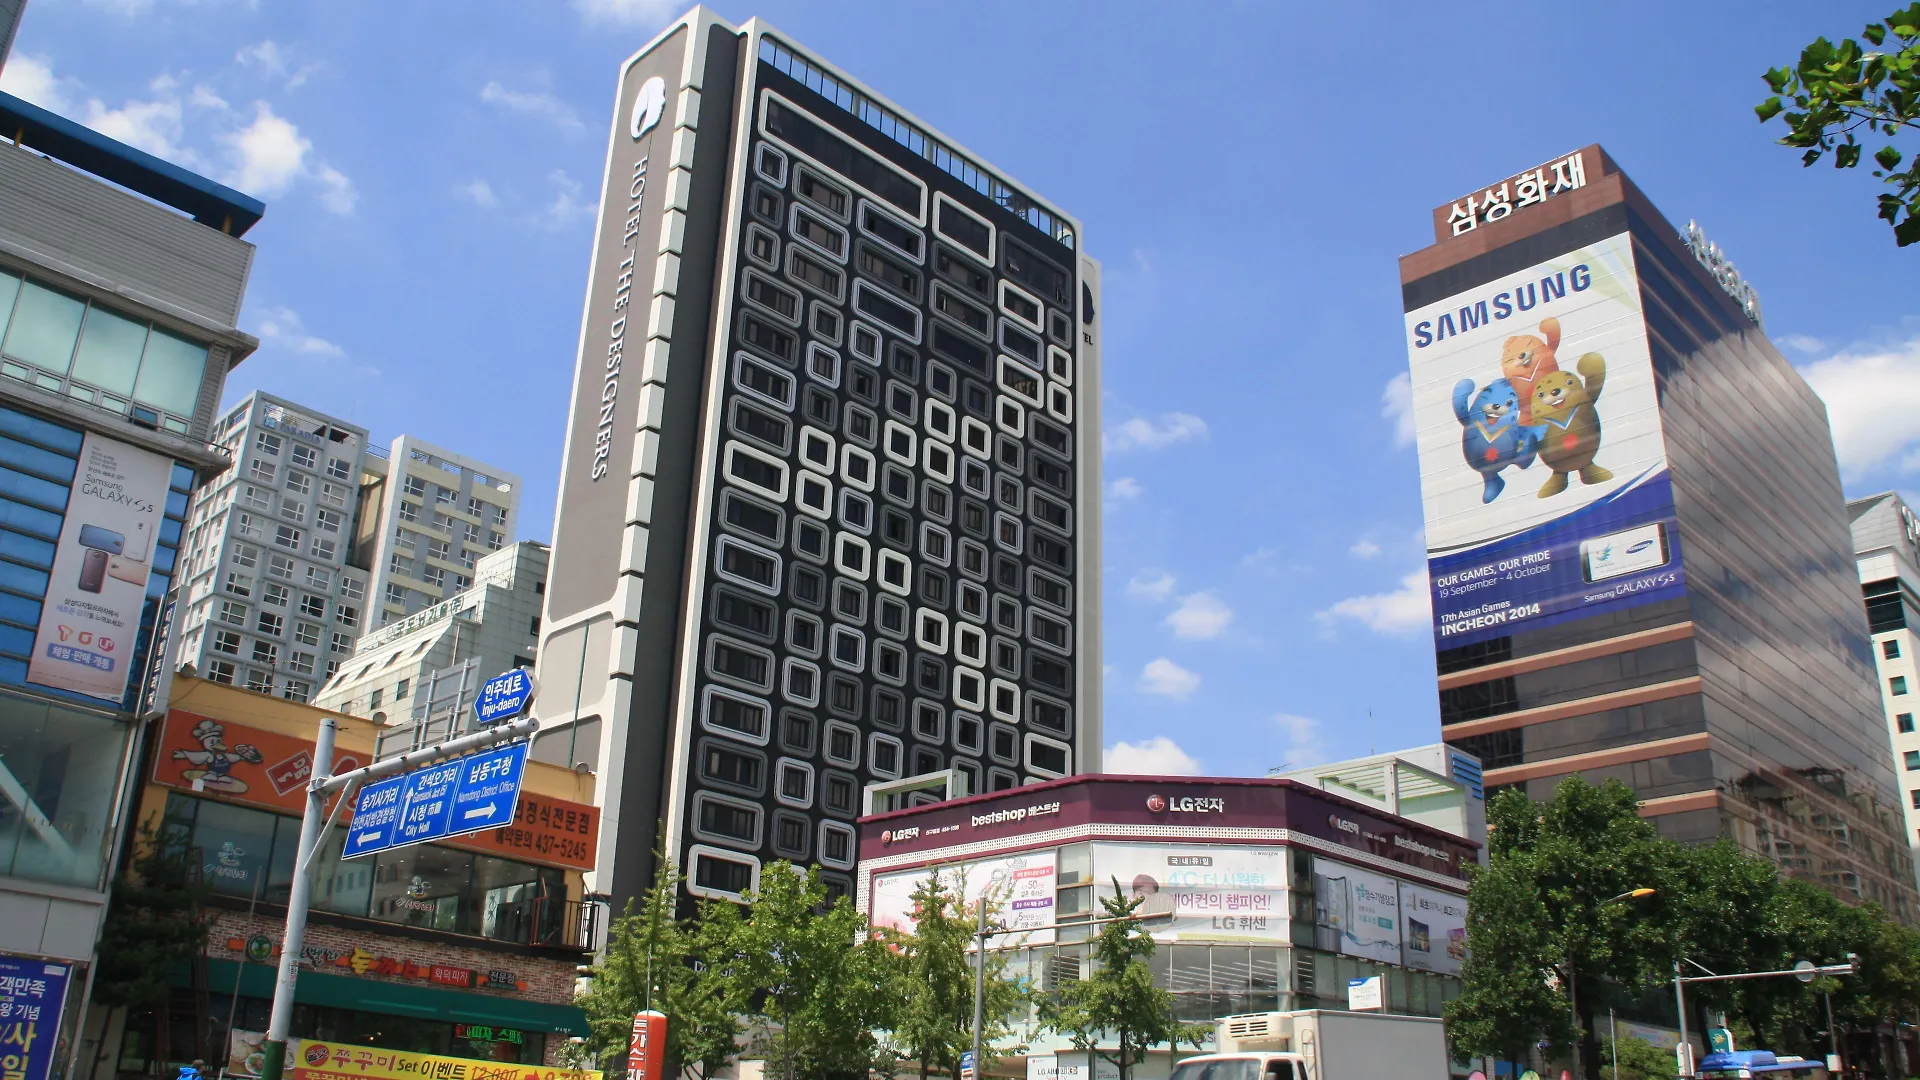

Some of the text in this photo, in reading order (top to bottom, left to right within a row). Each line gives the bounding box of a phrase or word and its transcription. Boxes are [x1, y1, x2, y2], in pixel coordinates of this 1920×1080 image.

[1447, 153, 1587, 237] 삼성화재
[1413, 262, 1593, 350] SAMSUNG
[591, 155, 649, 482] HOTEL THE DESIGNERS
[1083, 331, 1093, 346] EL
[86, 473, 124, 493] Samsung
[82, 483, 133, 507] GALAXY
[1437, 575, 1458, 588] OUR
[1499, 558, 1520, 572] OUR
[1522, 550, 1551, 566] PRIDE
[1439, 588, 1449, 599] 19
[1450, 577, 1497, 596] September
[1506, 572, 1513, 581] 4
[1514, 563, 1551, 579] October
[1584, 590, 1615, 603] Samsung
[1616, 577, 1656, 595] GALAXY
[1441, 600, 1511, 624] 17th Asian Games
[1441, 602, 1541, 637] INCHEON 2014
[485, 674, 523, 703] 인주대로
[482, 697, 520, 718] Inju-daero
[418, 765, 459, 791] 간석오거리
[469, 755, 513, 785] 남동구청
[408, 802, 426, 823] 시청
[1169, 796, 1225, 813] LG전자
[971, 807, 1027, 828] bestshop
[405, 820, 431, 838] City Hall
[892, 826, 920, 842] LG전자
[535, 834, 588, 861] 437-5245
[1394, 834, 1430, 857] bestshop
[1203, 872, 1217, 889] 더
[1222, 871, 1266, 889] 시원한
[1225, 893, 1271, 911] 챔피언!
[1212, 915, 1267, 931] LG 휘센
[435, 967, 468, 984] 화덕피자
[490, 970, 516, 983] 전문점
[16, 1004, 41, 1020] 기념
[1034, 1033, 1046, 1043] PC
[397, 1058, 418, 1073] Set
